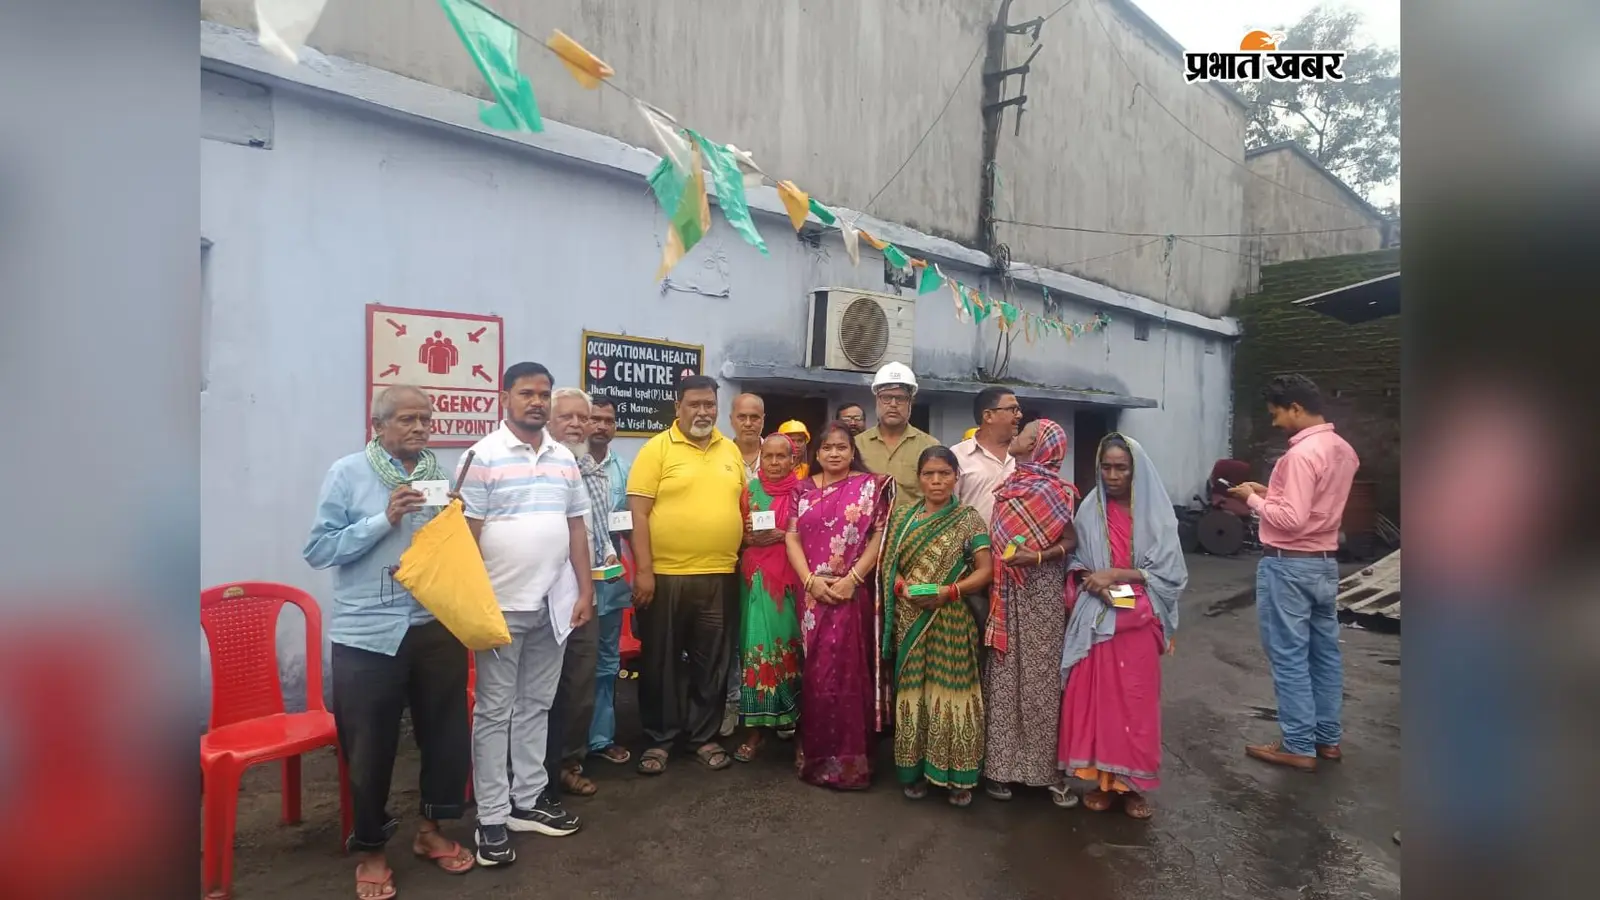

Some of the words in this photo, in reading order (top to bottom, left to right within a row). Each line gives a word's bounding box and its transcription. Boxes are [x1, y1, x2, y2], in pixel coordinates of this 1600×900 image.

[587, 340, 660, 362] OCCUPATIONAL
[661, 349, 698, 365] HEALTH
[614, 361, 674, 386] CENTRE
[428, 394, 495, 412] RGENCY
[456, 420, 496, 435] POINT
[627, 418, 645, 430] Visit
